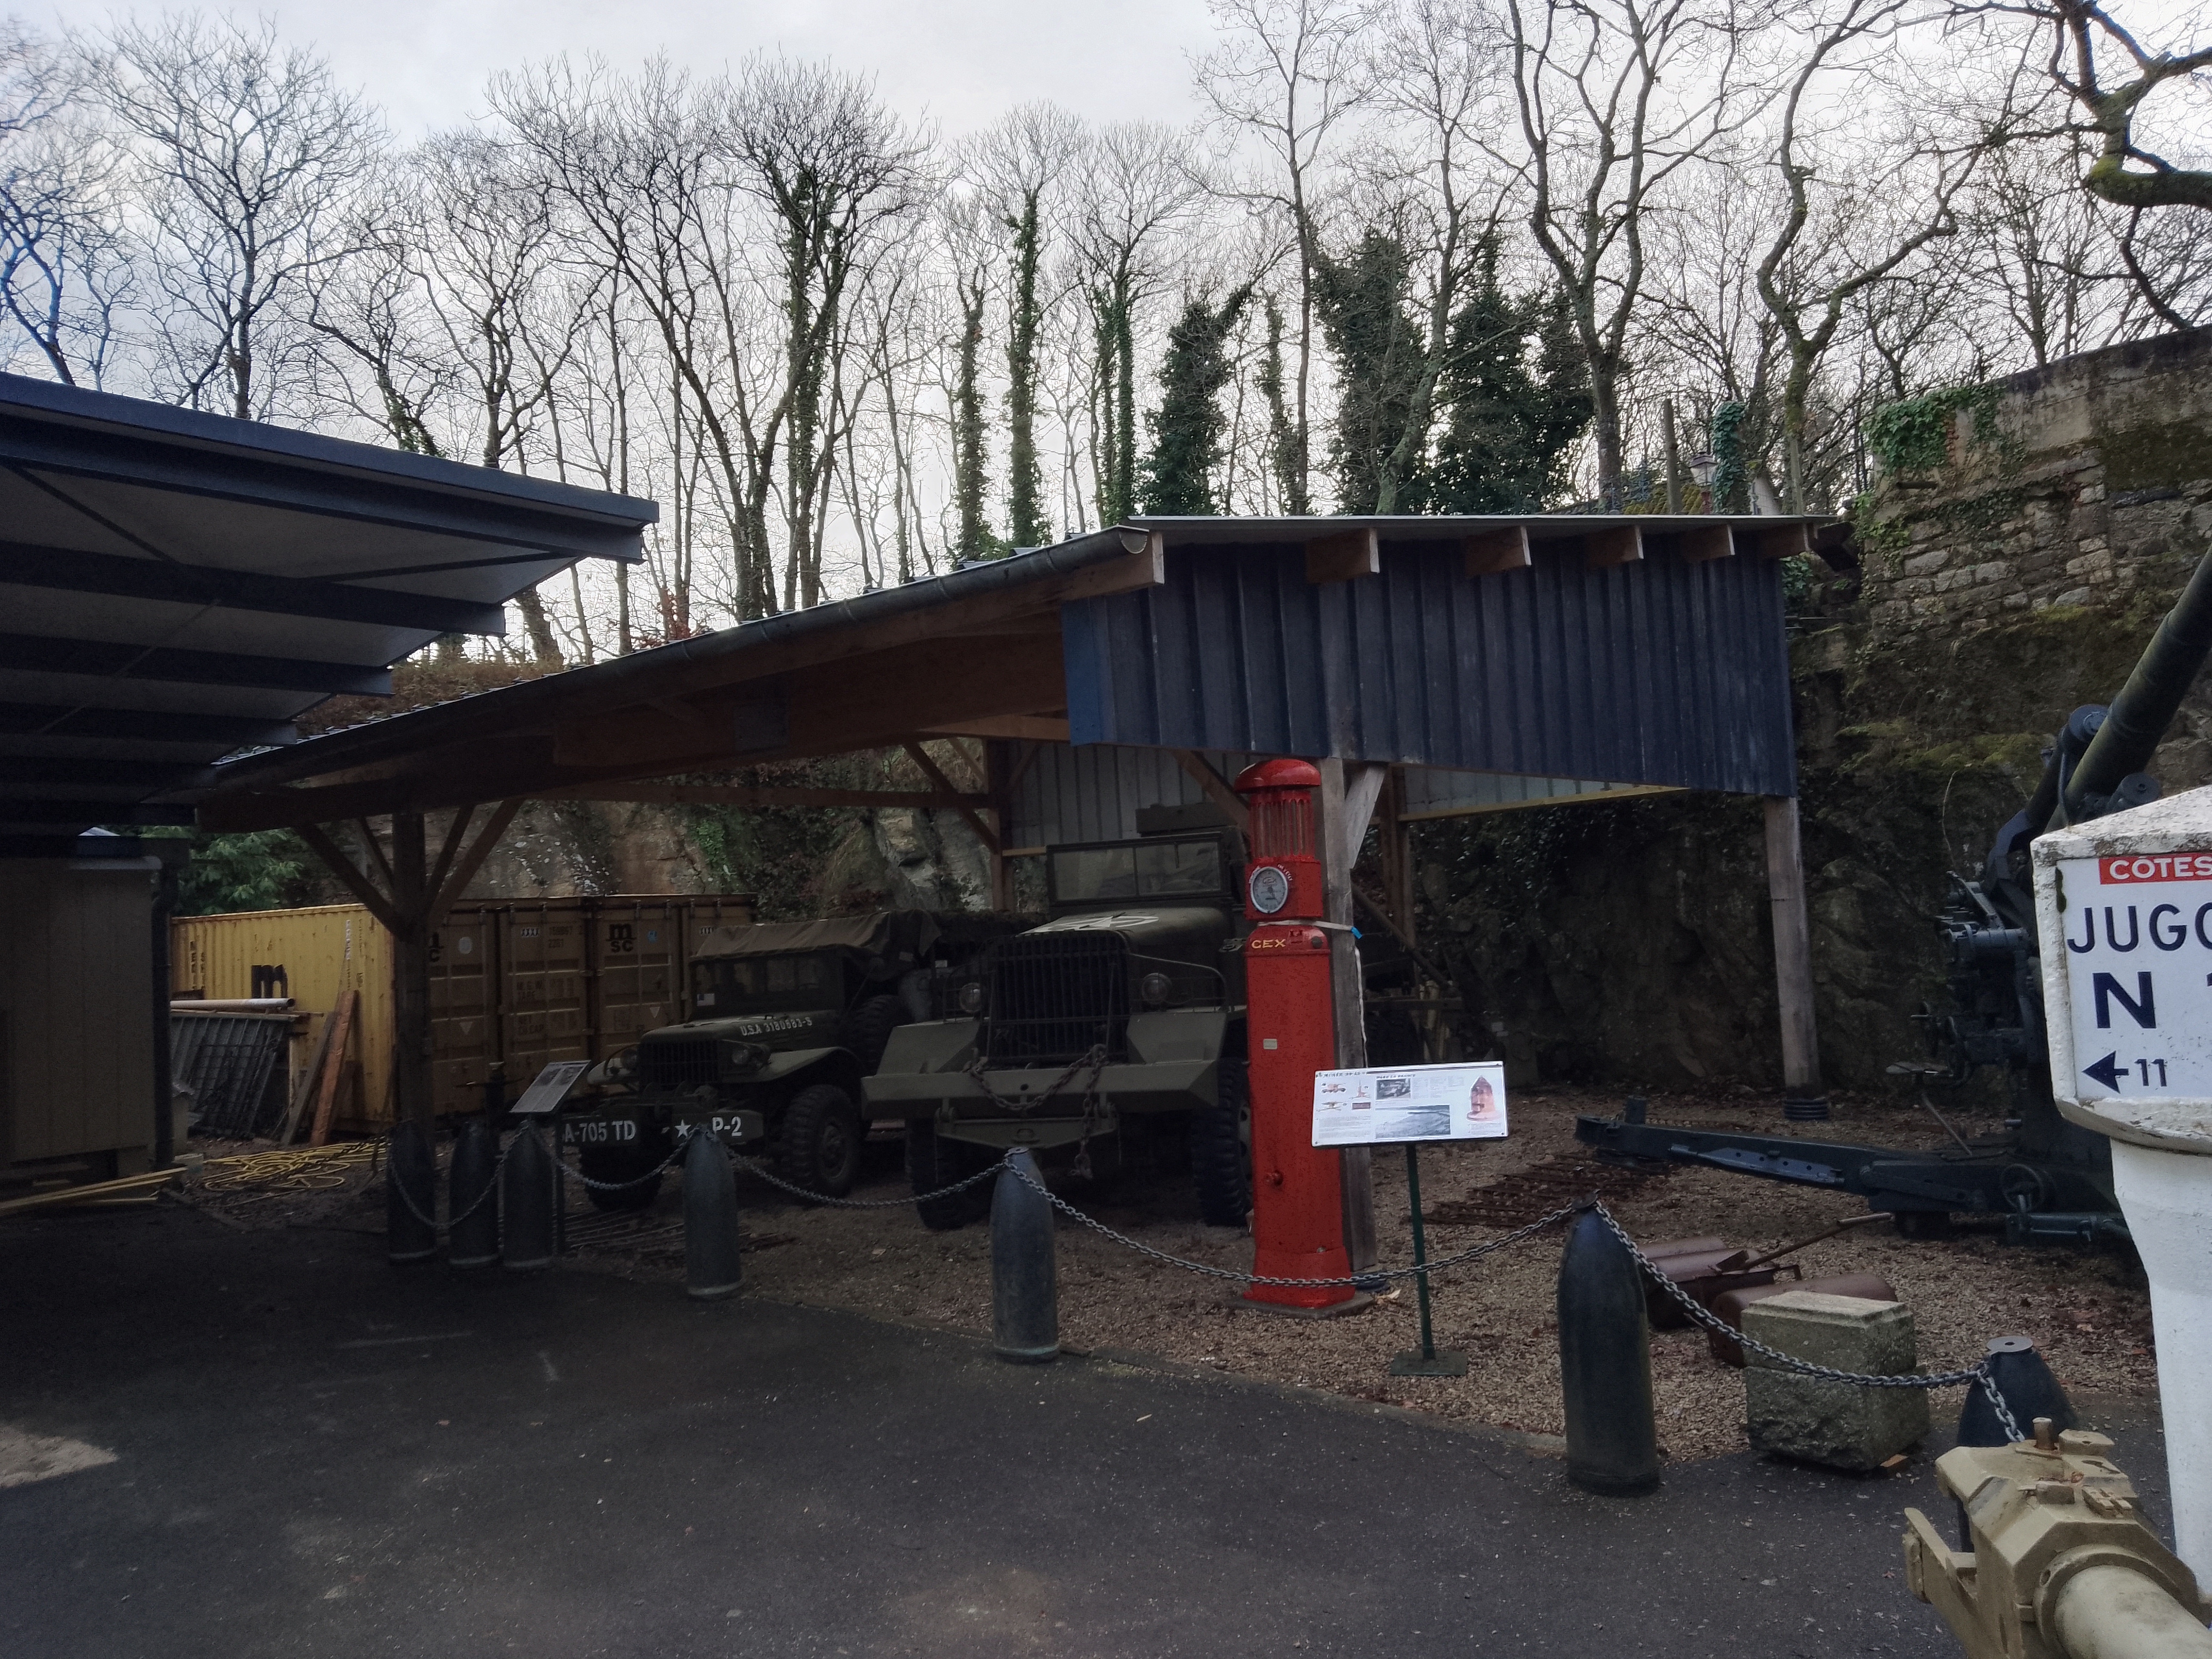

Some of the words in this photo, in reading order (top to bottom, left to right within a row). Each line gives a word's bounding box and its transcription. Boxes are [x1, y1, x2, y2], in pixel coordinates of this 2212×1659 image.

[2092, 970, 2157, 1029] N
[2134, 1058, 2168, 1087] 11
[563, 1121, 608, 1143] A-705
[611, 1119, 636, 1141] TD
[711, 1116, 743, 1137] P-2
